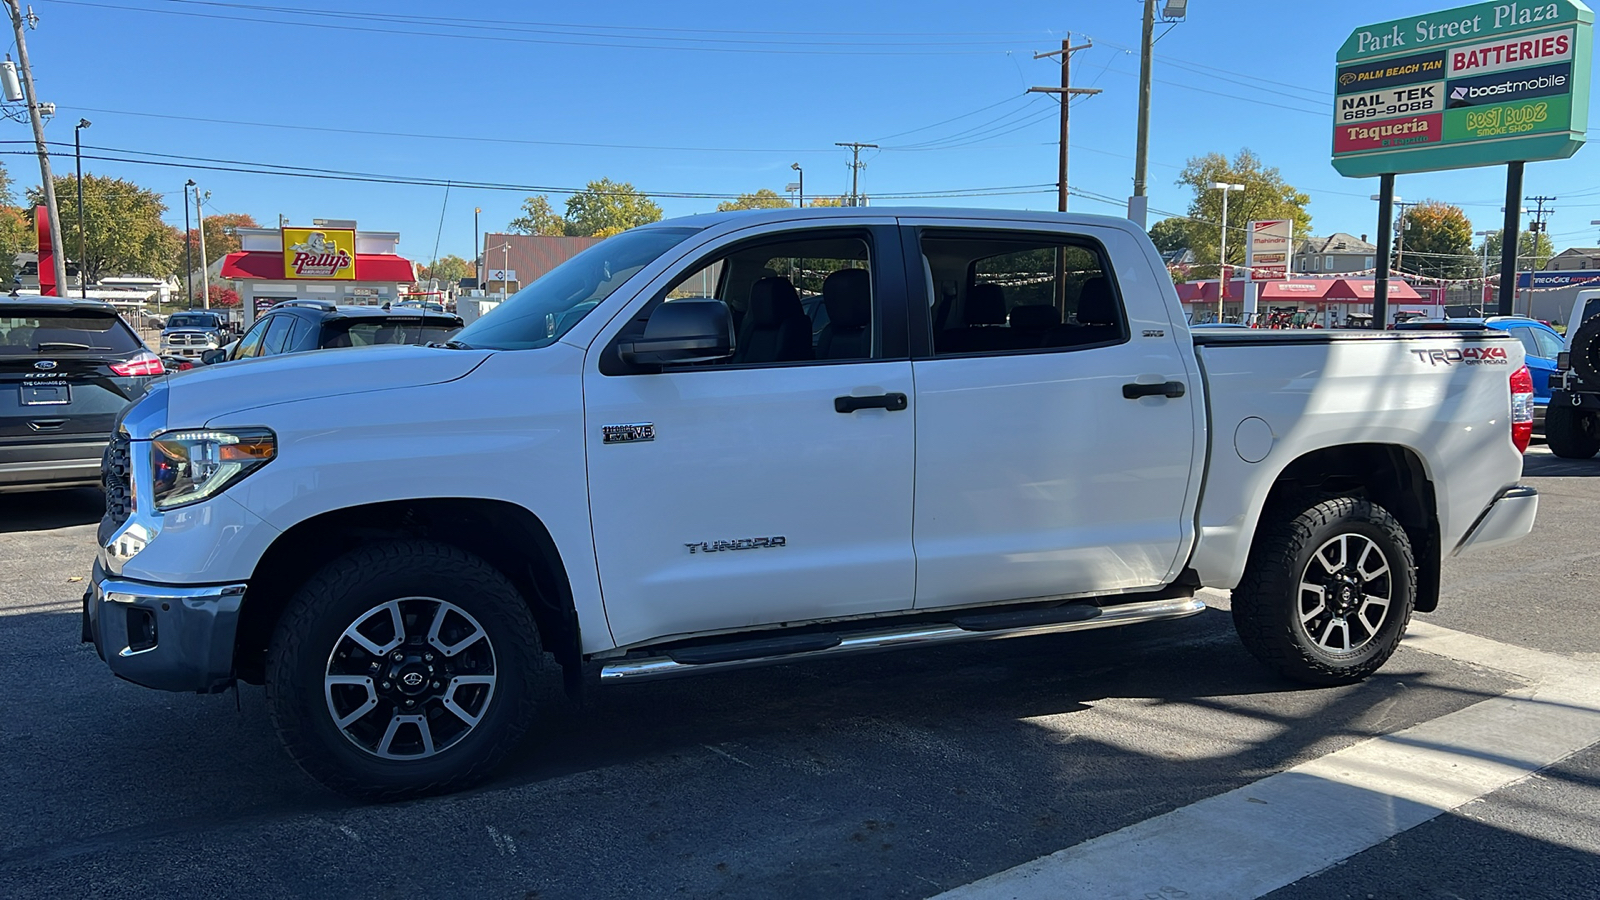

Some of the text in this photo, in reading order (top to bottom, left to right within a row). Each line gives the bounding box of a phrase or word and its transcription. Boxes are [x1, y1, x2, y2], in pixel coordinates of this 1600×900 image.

[1357, 2, 1559, 53] Park Street Plaza
[1453, 34, 1569, 71] BATTERIES
[1358, 59, 1443, 82] PALM BEACH TAN
[1342, 85, 1435, 110] NAIL TEK
[1343, 100, 1433, 120] 689-9088
[1504, 102, 1548, 126] BUDZ
[1477, 123, 1533, 137] SMOKE SHOP
[290, 249, 351, 275] Rally's
[1410, 348, 1464, 366] TRD
[684, 535, 786, 554] TUNDRA
